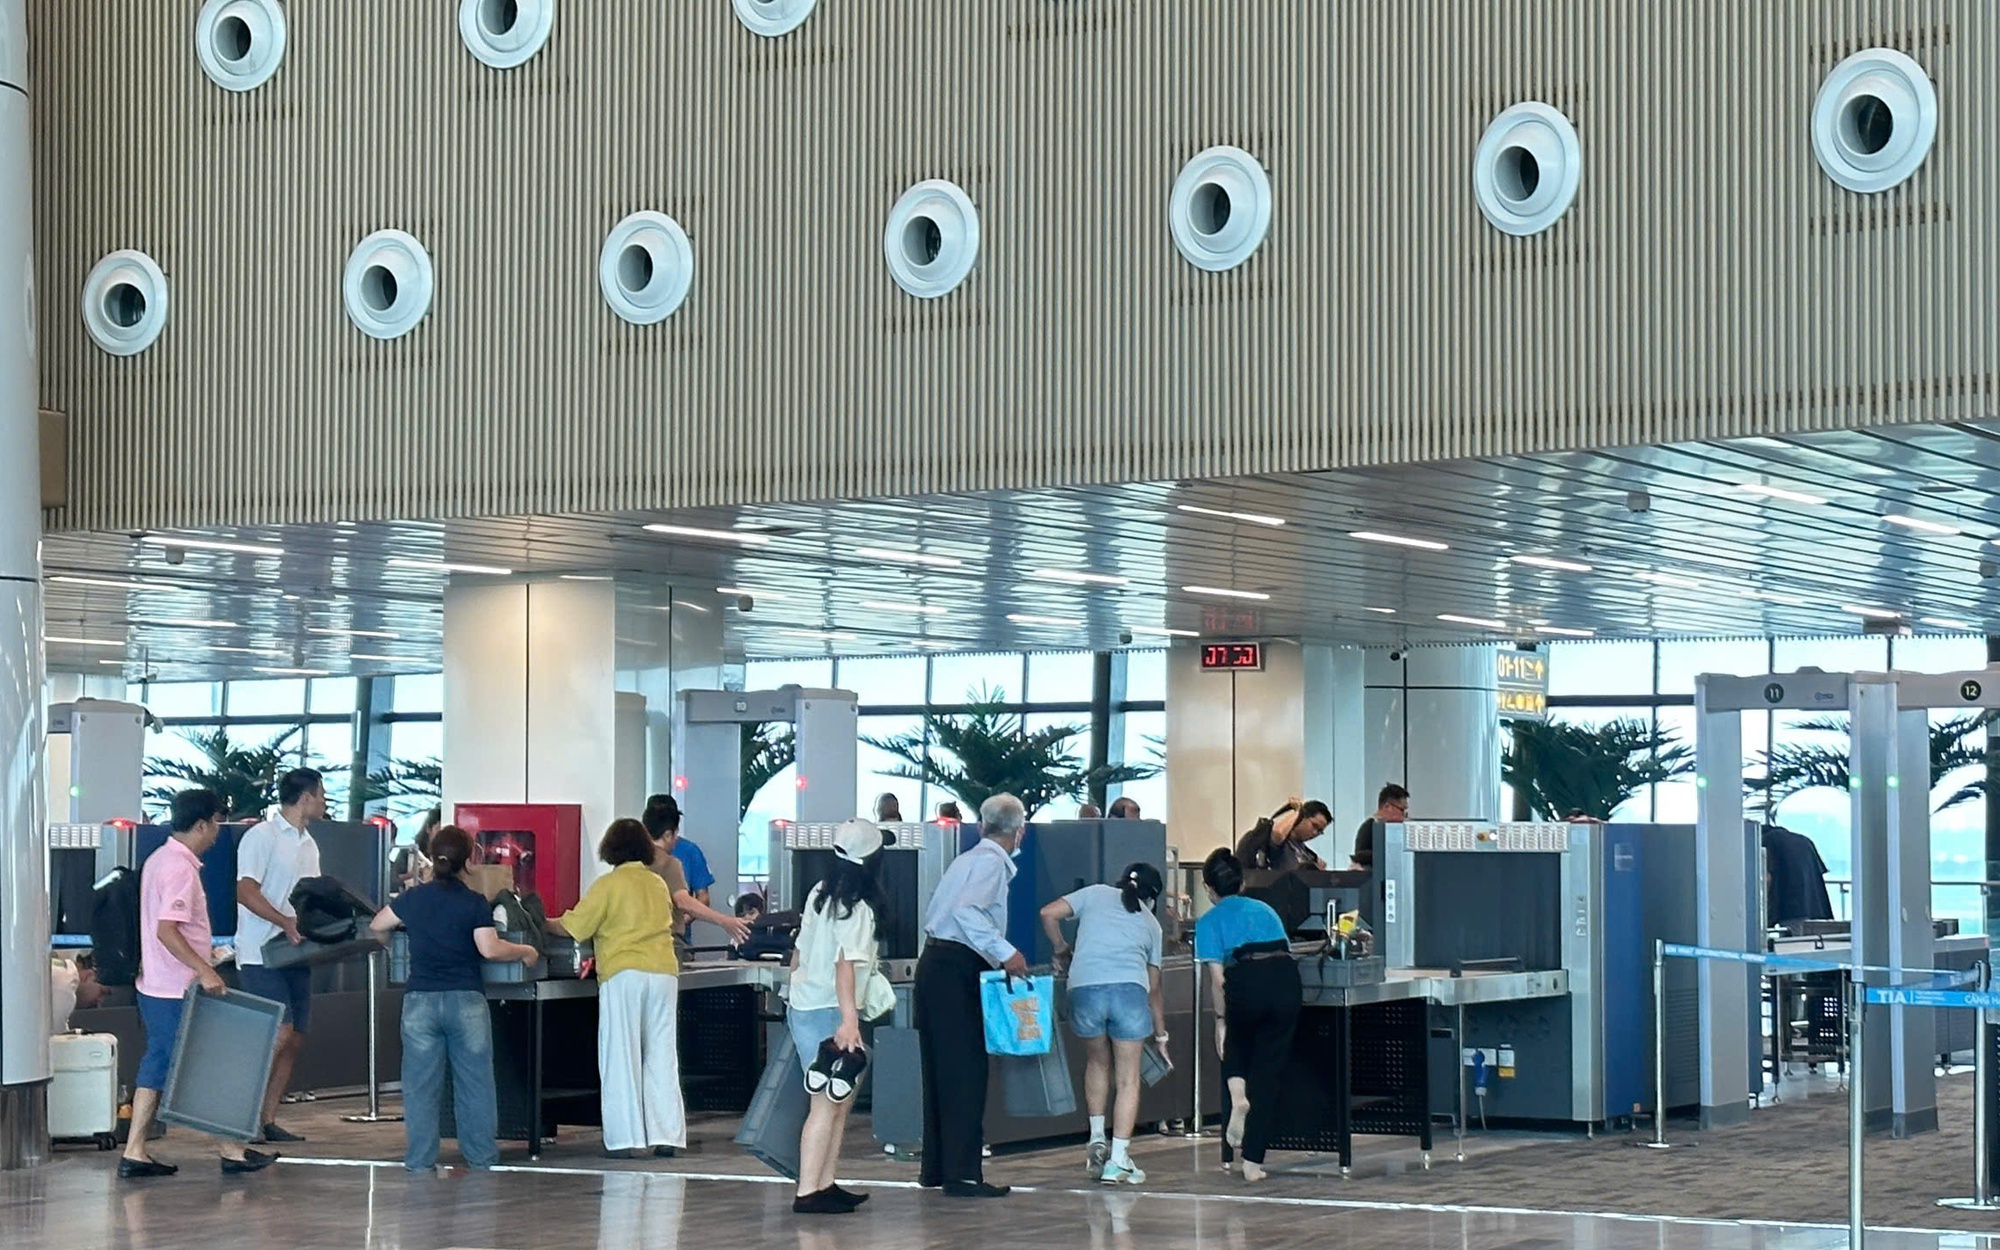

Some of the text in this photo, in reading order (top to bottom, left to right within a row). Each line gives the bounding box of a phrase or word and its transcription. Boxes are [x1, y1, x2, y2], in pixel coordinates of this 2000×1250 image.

[1498, 653, 1525, 679] 01-11
[1769, 687, 1780, 698] 11
[1965, 685, 1977, 697] 12
[1877, 990, 1907, 1003] TIA
